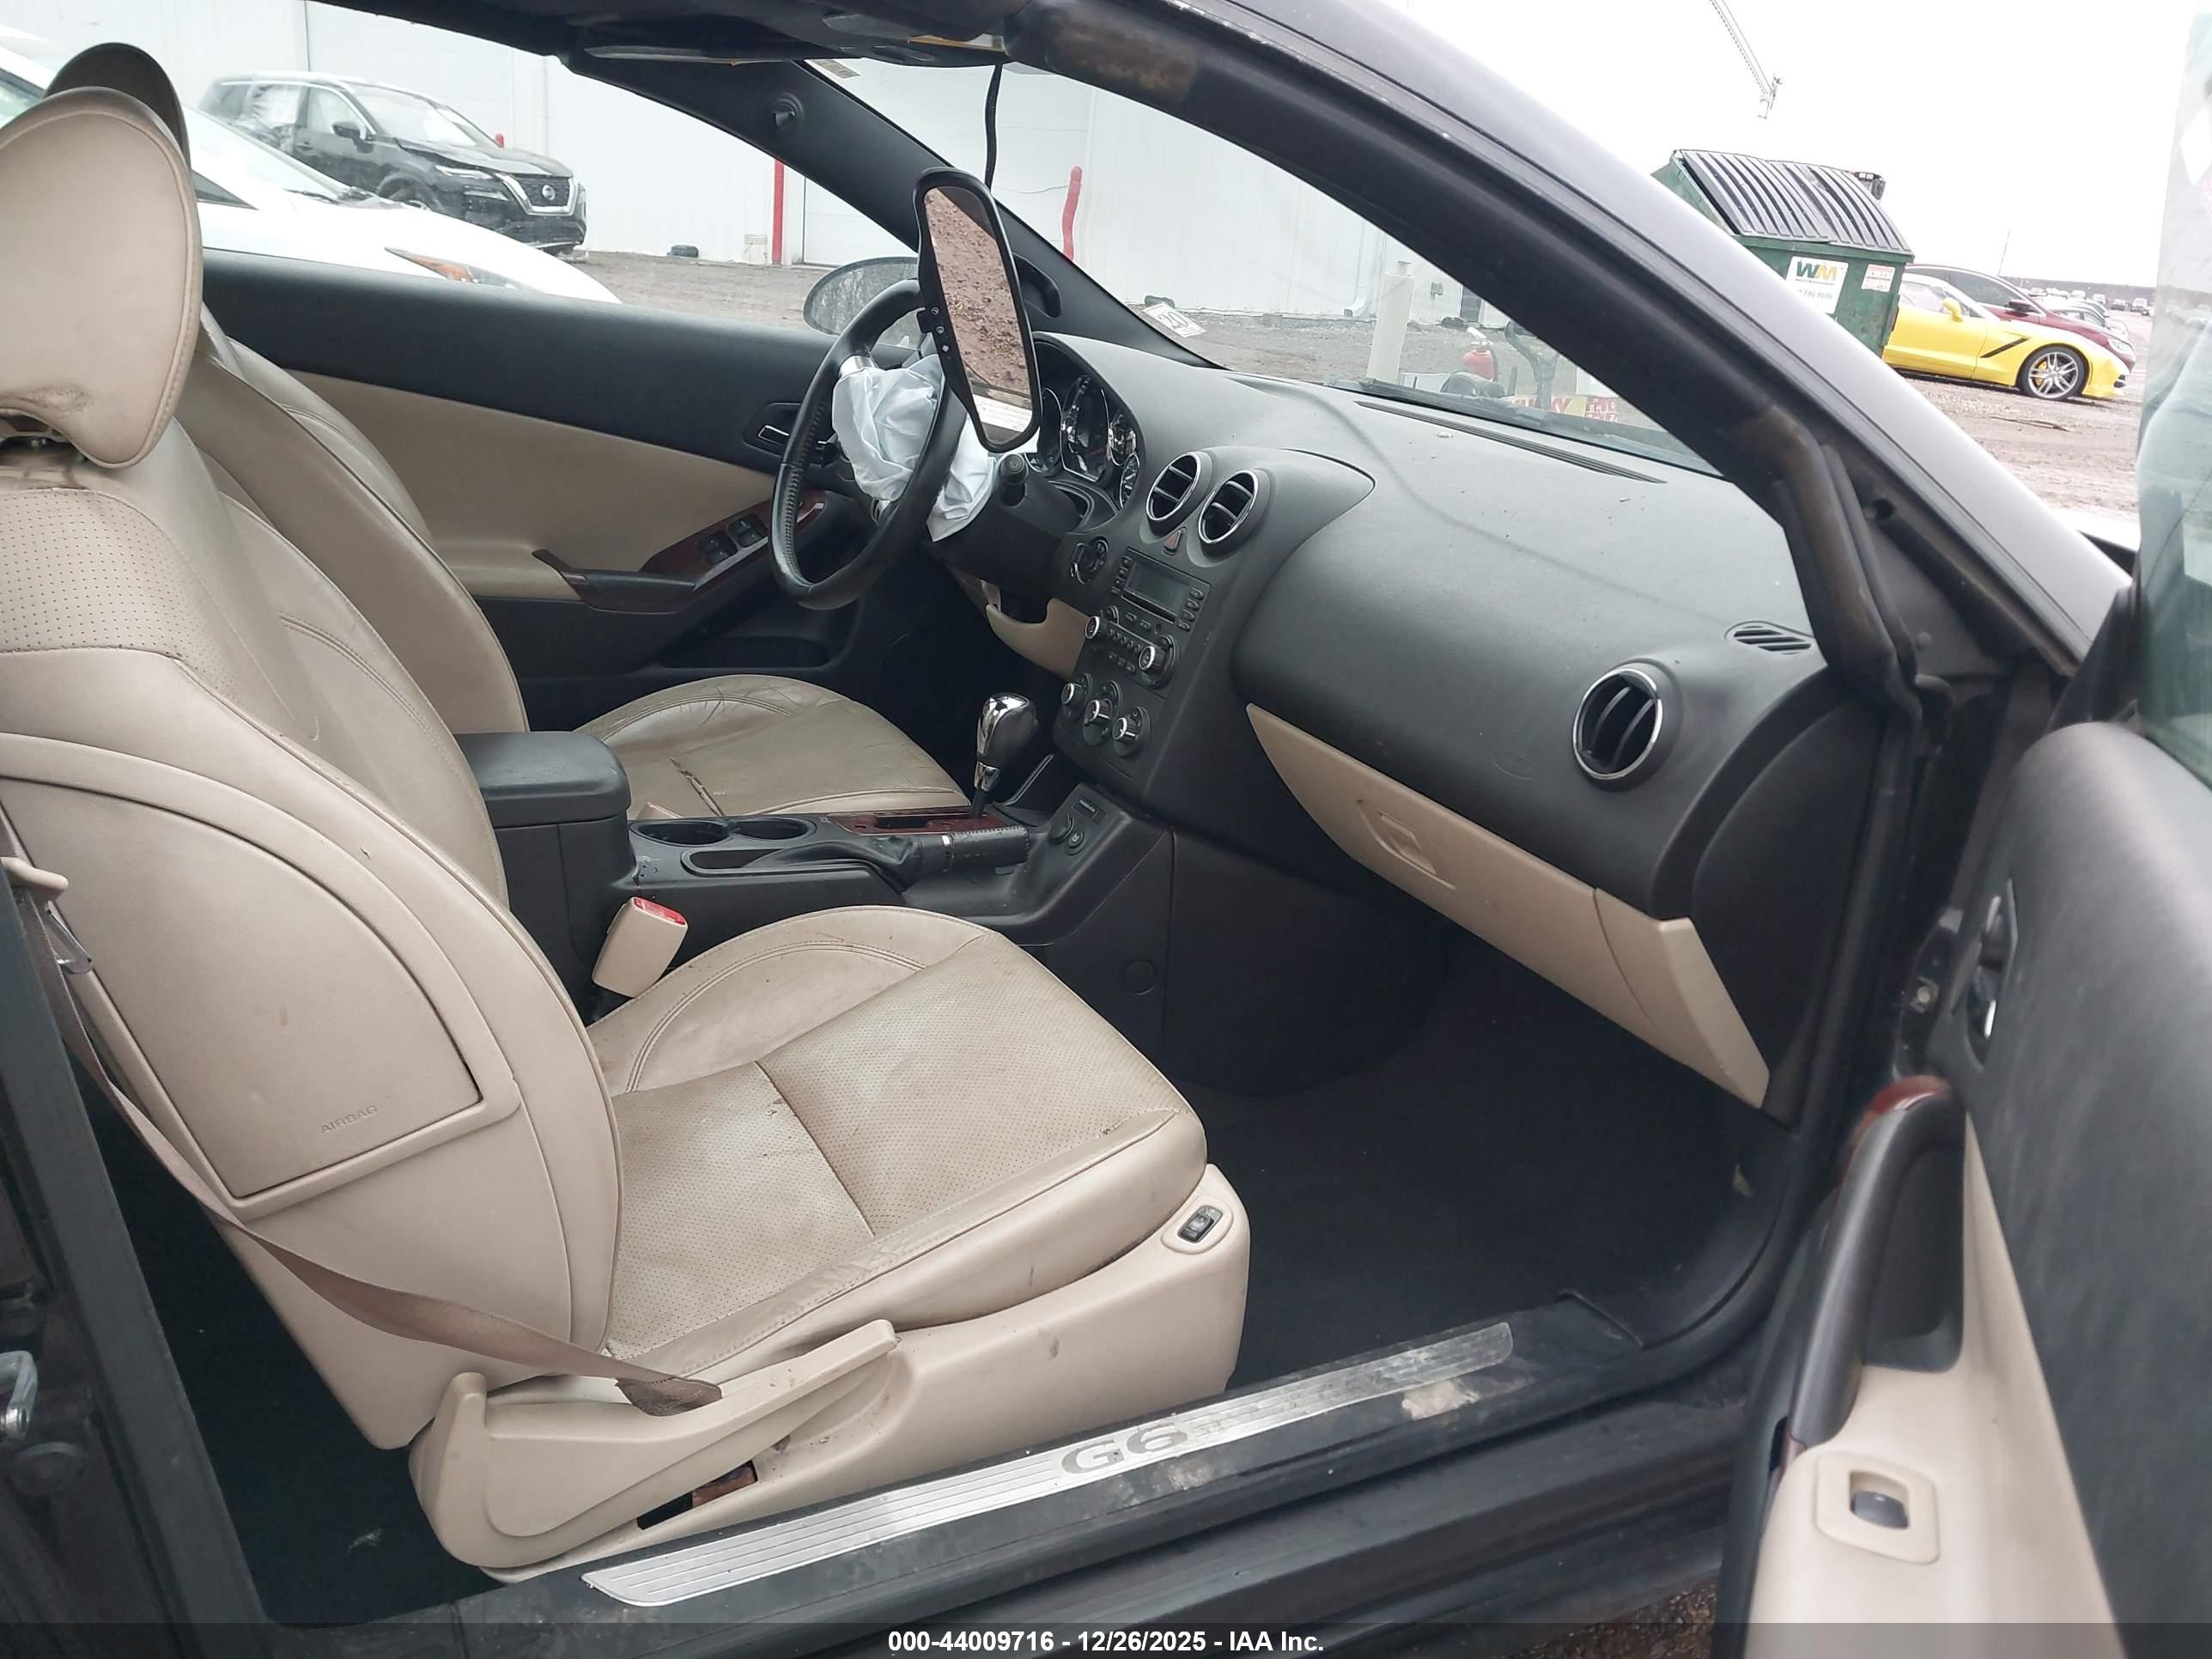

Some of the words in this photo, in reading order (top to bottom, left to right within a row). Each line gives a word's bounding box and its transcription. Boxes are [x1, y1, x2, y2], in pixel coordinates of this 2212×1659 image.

[1796, 261, 1838, 282] WM
[320, 1105, 379, 1134] AIRBAG
[1061, 1422, 1188, 1474] G6
